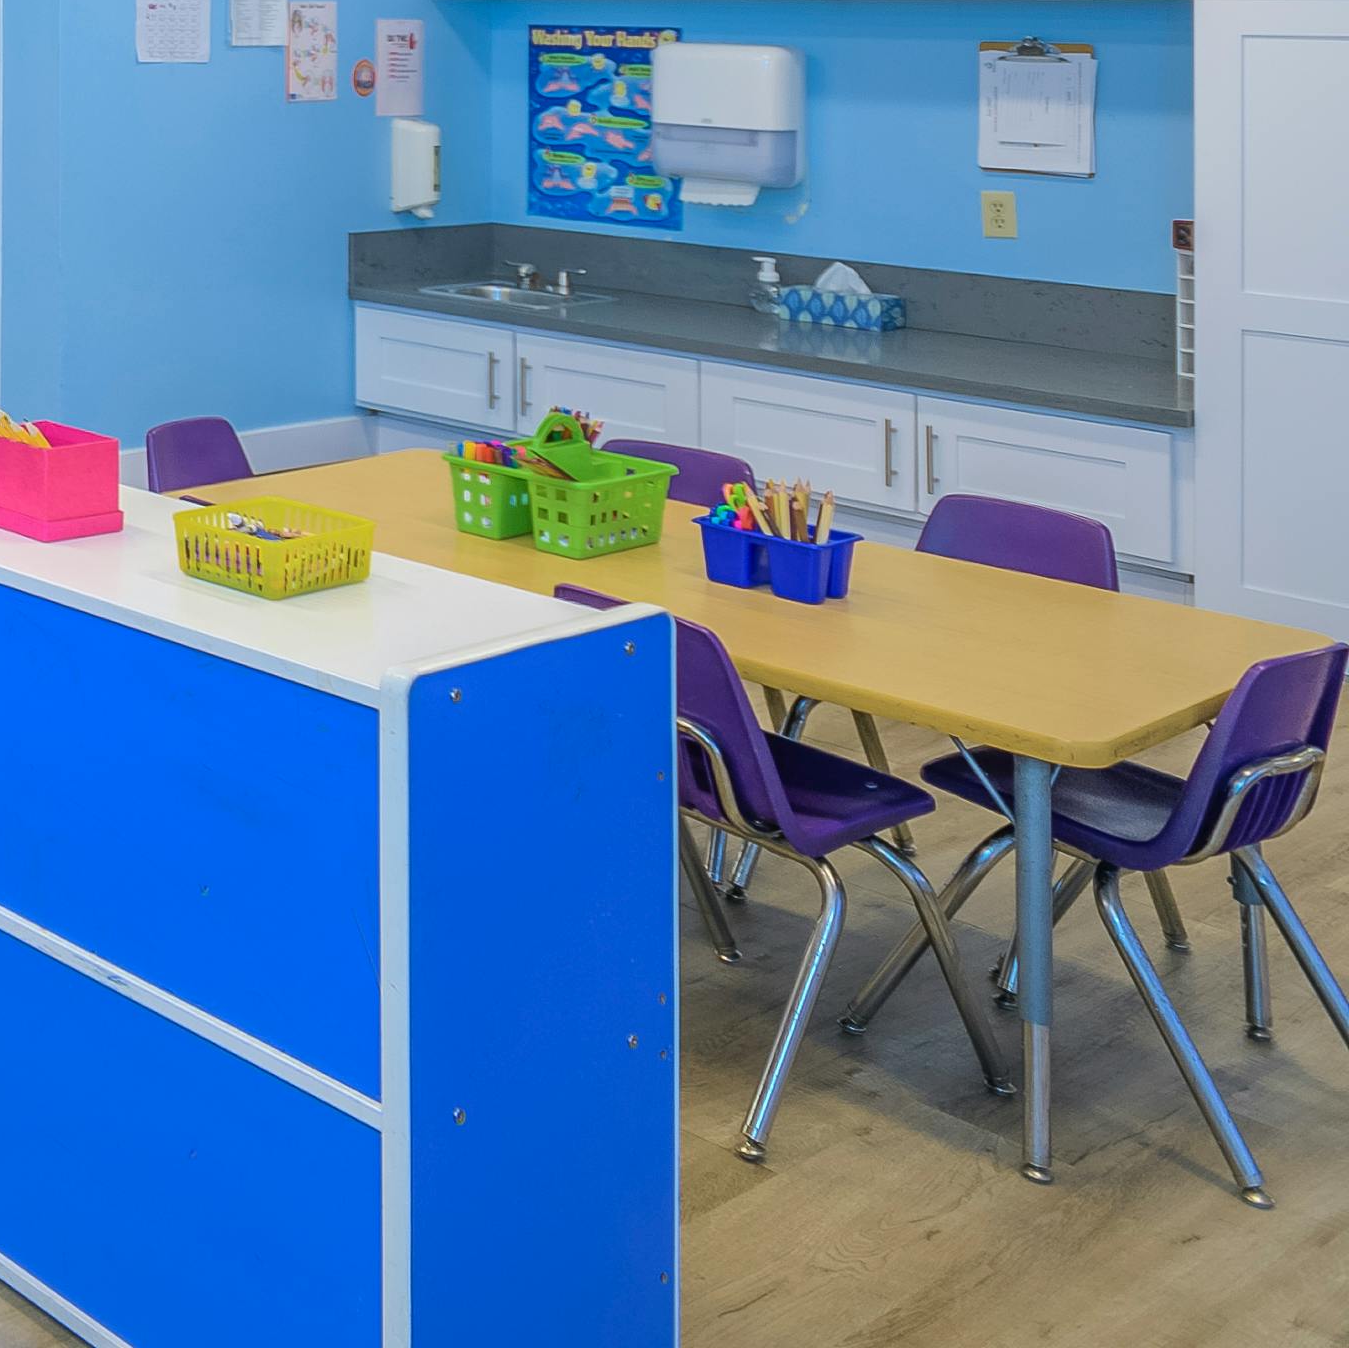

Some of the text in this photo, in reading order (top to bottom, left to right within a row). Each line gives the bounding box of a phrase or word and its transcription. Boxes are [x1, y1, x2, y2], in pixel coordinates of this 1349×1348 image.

[531, 28, 657, 50] Washing Your Hands
